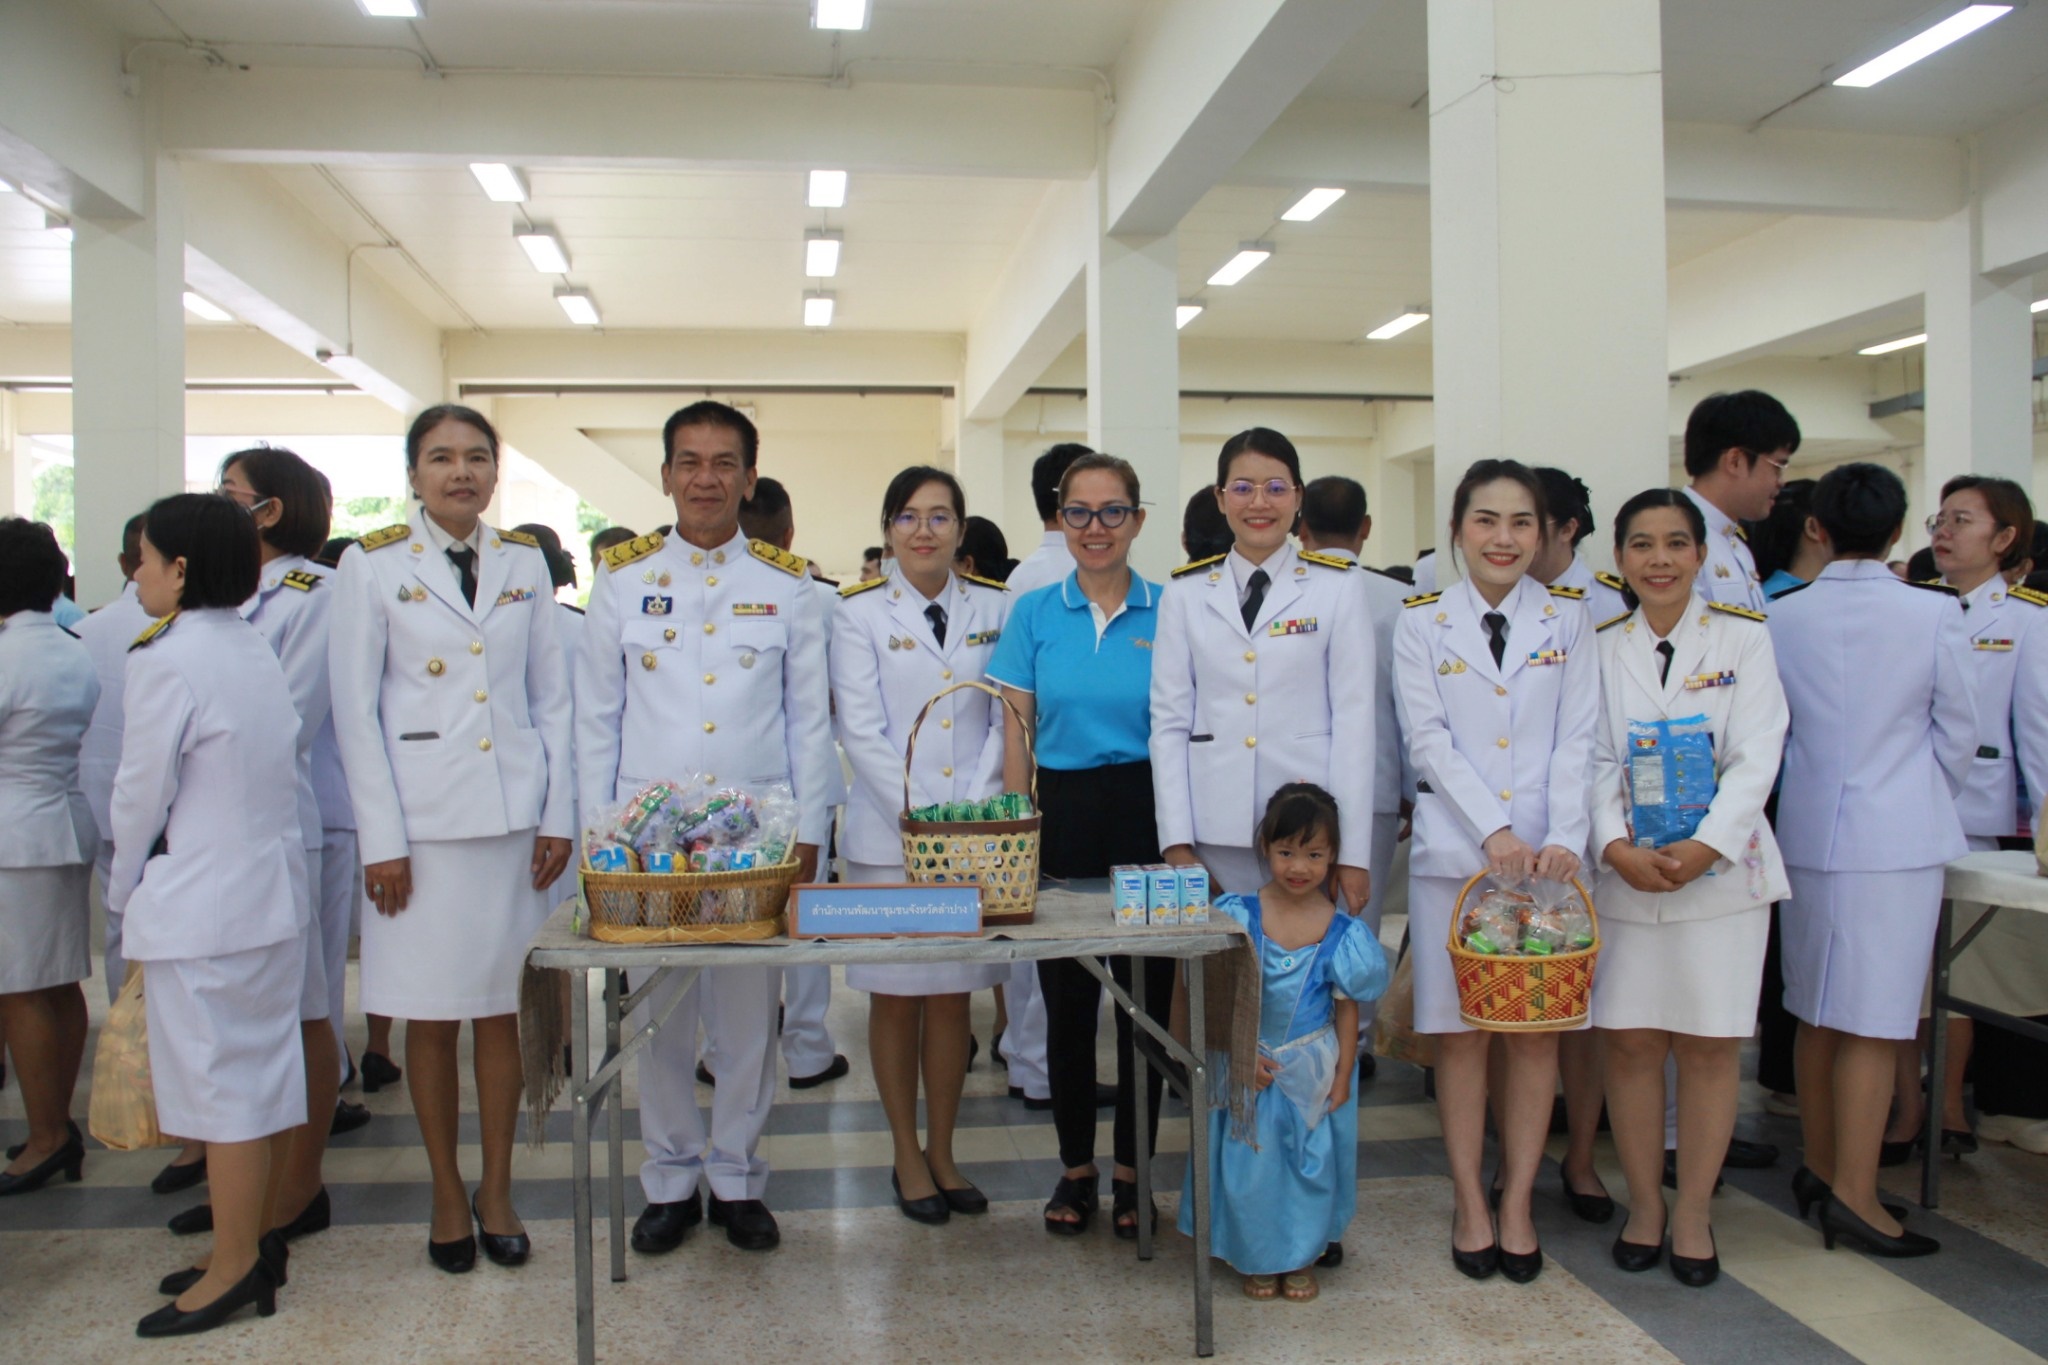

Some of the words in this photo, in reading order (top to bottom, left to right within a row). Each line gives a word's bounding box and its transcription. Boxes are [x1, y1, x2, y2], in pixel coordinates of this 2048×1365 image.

[812, 902, 968, 918] สำนักงานพัฒนาชุมชนจังหวัดลำปาง
